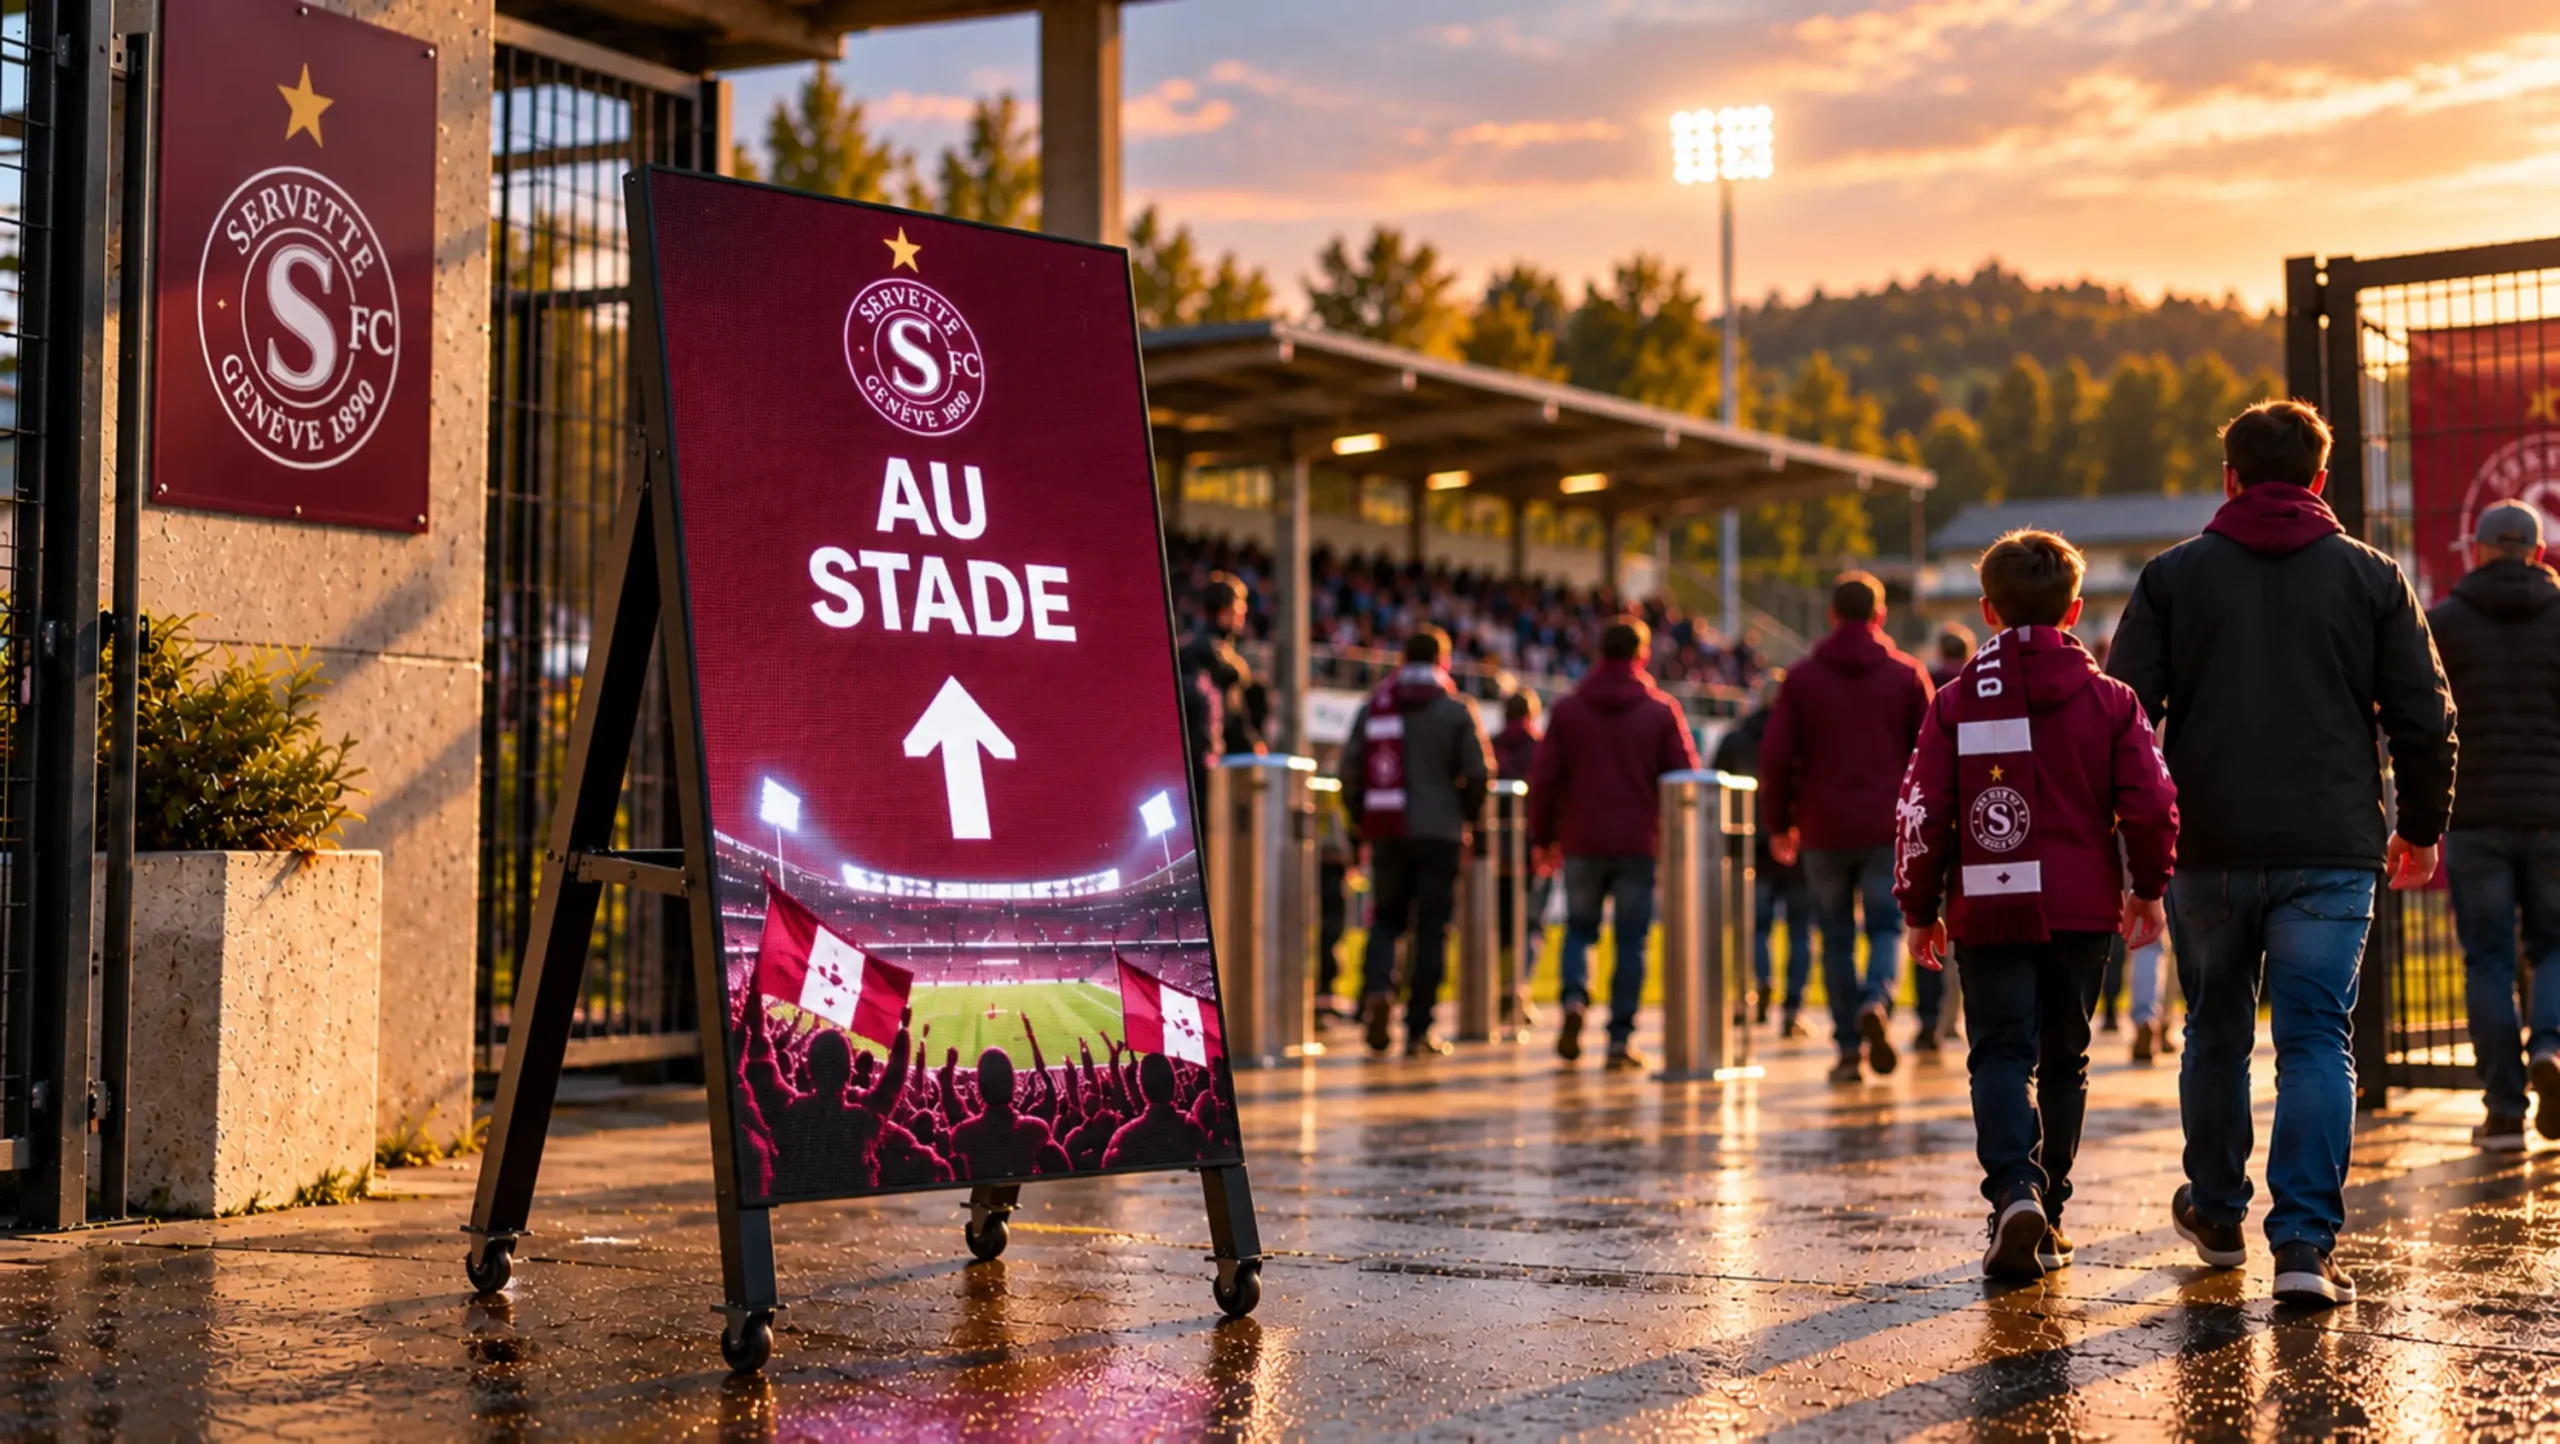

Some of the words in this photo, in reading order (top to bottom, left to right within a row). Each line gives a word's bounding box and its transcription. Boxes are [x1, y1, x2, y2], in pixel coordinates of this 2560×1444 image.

[226, 183, 375, 279] SERVETTE
[266, 243, 338, 392] S
[348, 304, 395, 357] FC
[887, 316, 942, 398] S
[947, 350, 981, 379] FC
[328, 378, 376, 444] 1890
[876, 456, 987, 541] AU
[808, 545, 1078, 643] STADE
